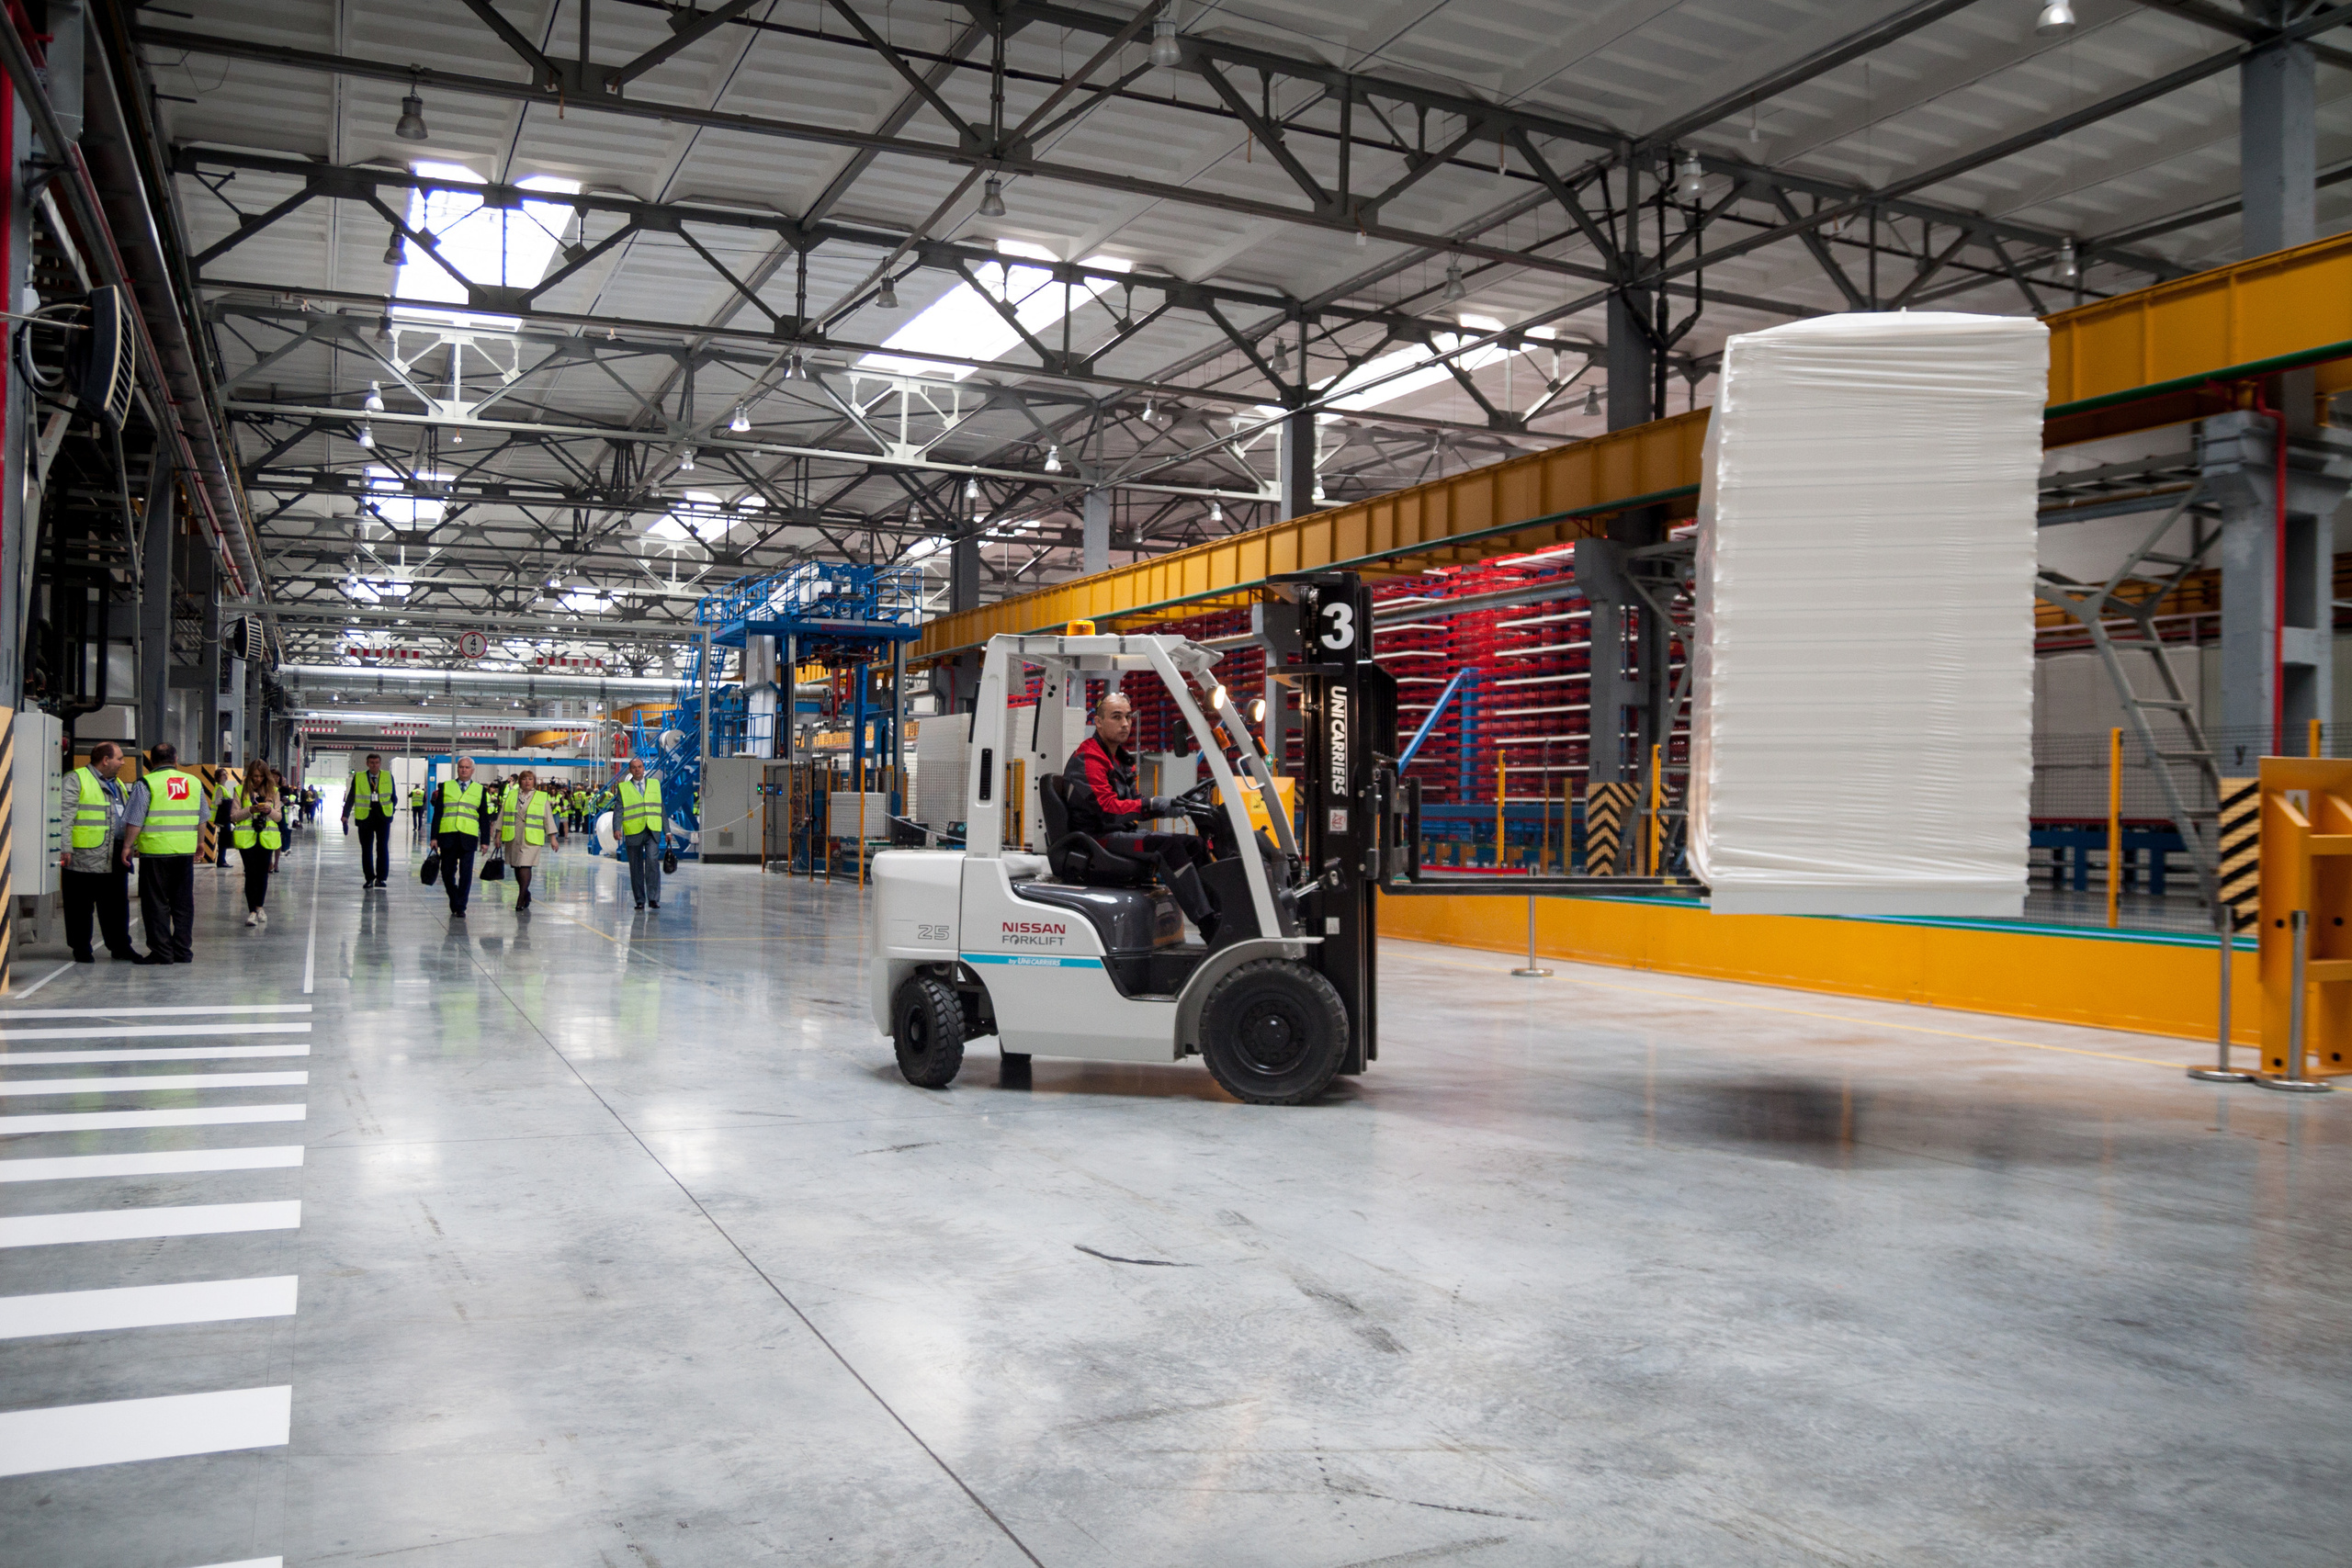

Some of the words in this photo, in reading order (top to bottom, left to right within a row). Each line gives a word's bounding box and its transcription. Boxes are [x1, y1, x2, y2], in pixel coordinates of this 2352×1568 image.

[1321, 603, 1354, 649] 3
[470, 637, 477, 647] 4
[1330, 686, 1347, 795] UNICARRIERS
[918, 925, 949, 940] 25
[1002, 922, 1066, 934] NISSAN
[1002, 935, 1065, 945] FORKLIFT
